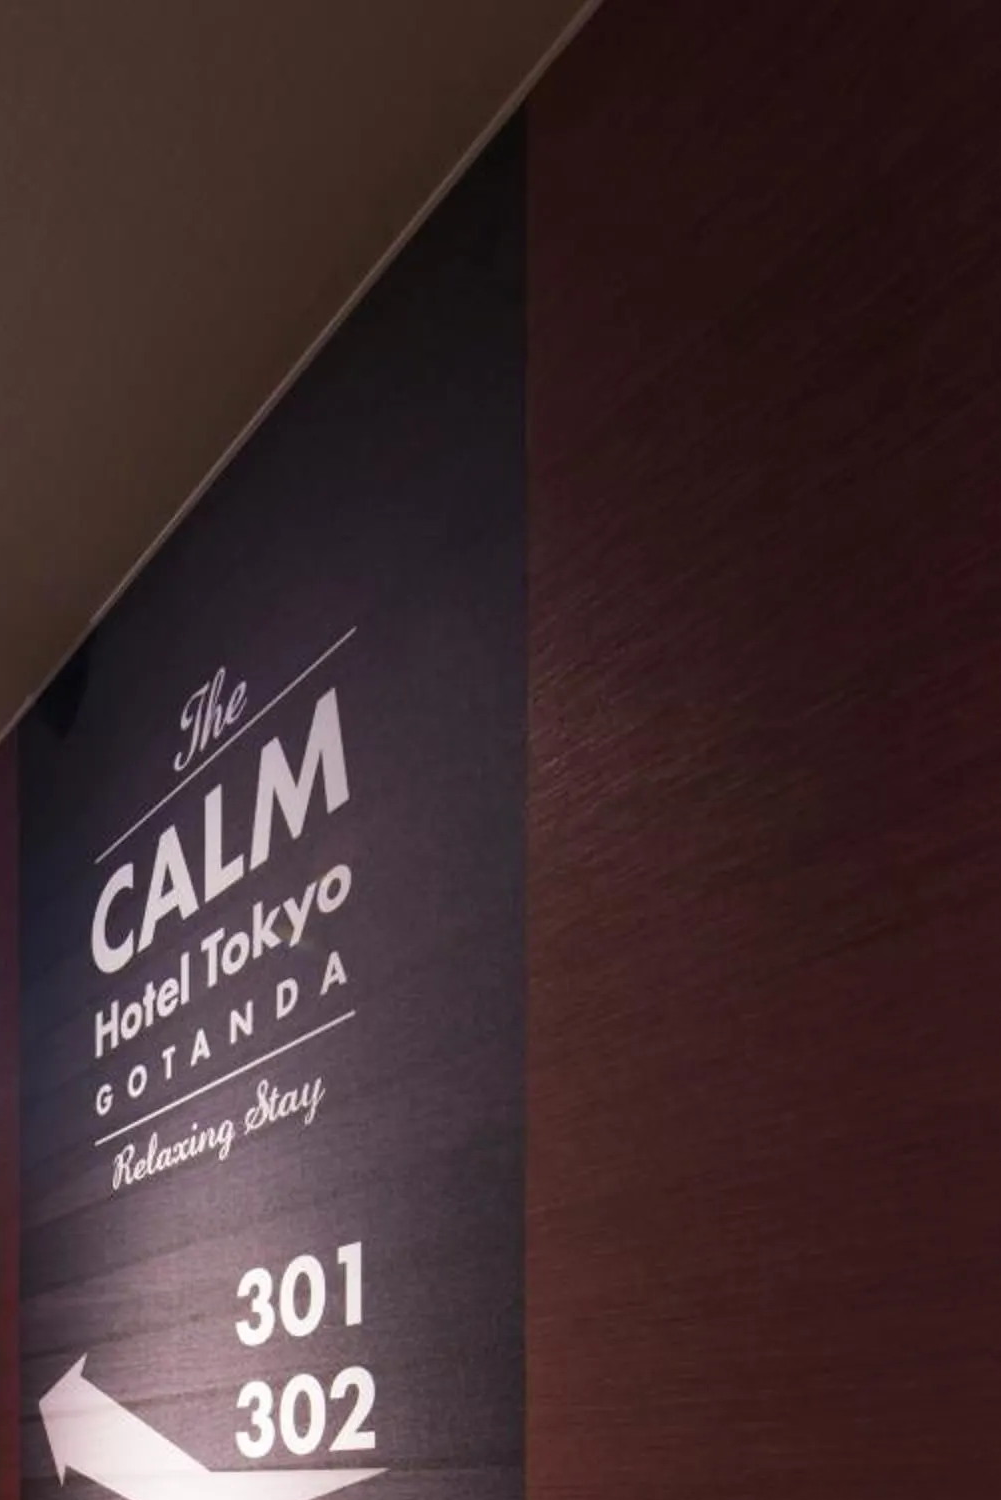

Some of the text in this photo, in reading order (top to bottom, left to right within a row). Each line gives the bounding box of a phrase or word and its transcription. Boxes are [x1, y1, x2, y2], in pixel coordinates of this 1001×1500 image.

[173, 666, 248, 772] The
[90, 687, 351, 974] CALM
[94, 864, 352, 1059] Hotel Tokyo
[95, 950, 348, 1117] GOTANDA
[111, 1076, 327, 1191] Relaxing Stay
[234, 1240, 363, 1348] 301
[234, 1365, 377, 1460] 302
